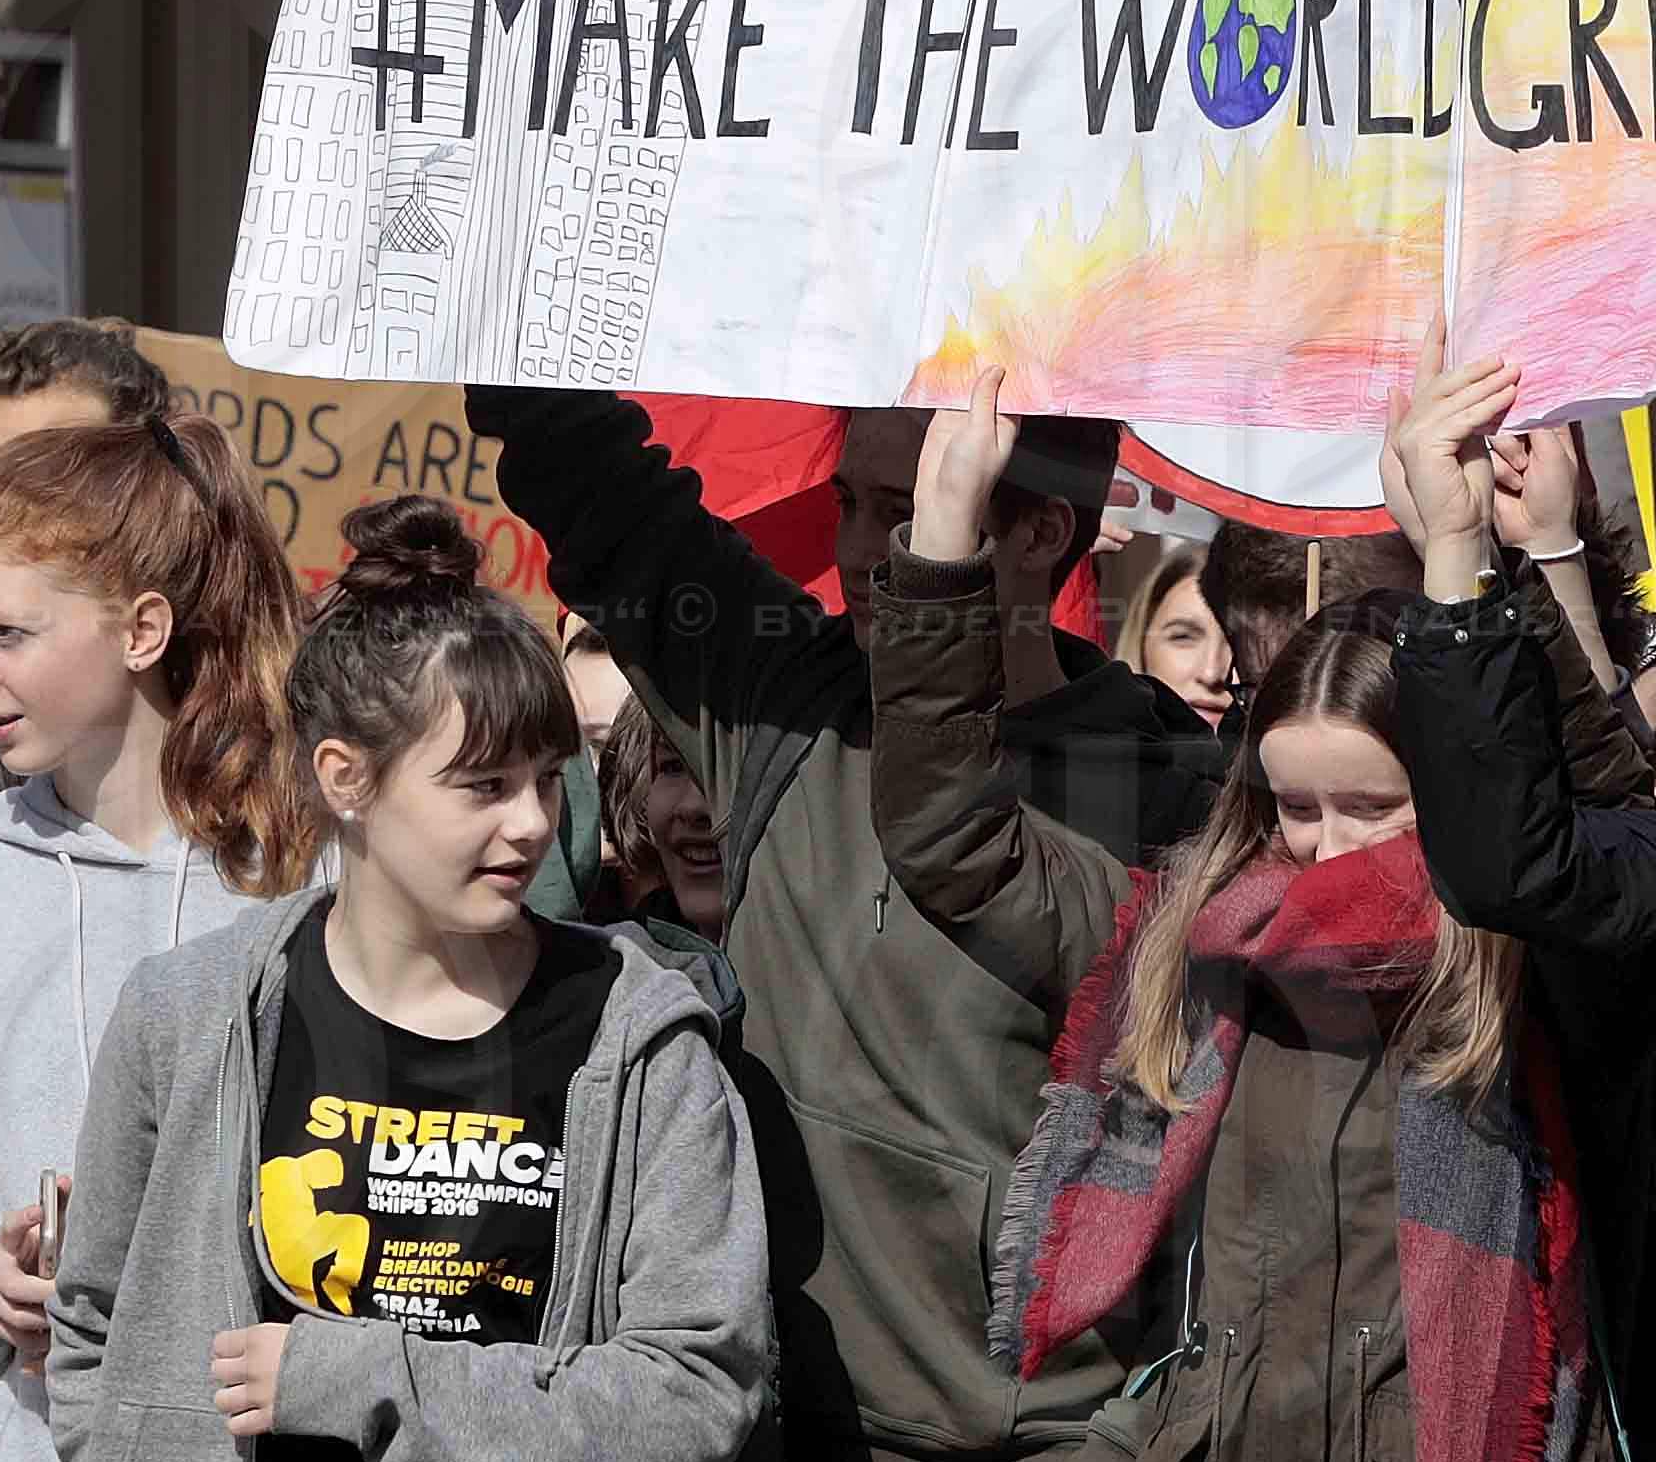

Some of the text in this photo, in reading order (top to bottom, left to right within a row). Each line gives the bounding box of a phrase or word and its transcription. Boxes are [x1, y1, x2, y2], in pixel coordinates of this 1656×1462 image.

[373, 421, 505, 506] ARE
[305, 1095, 526, 1146] STREET
[367, 1139, 566, 1190] DANCE
[366, 1176, 554, 1210] WORLDCHAMPION
[367, 1195, 481, 1218] SHIPS 2016
